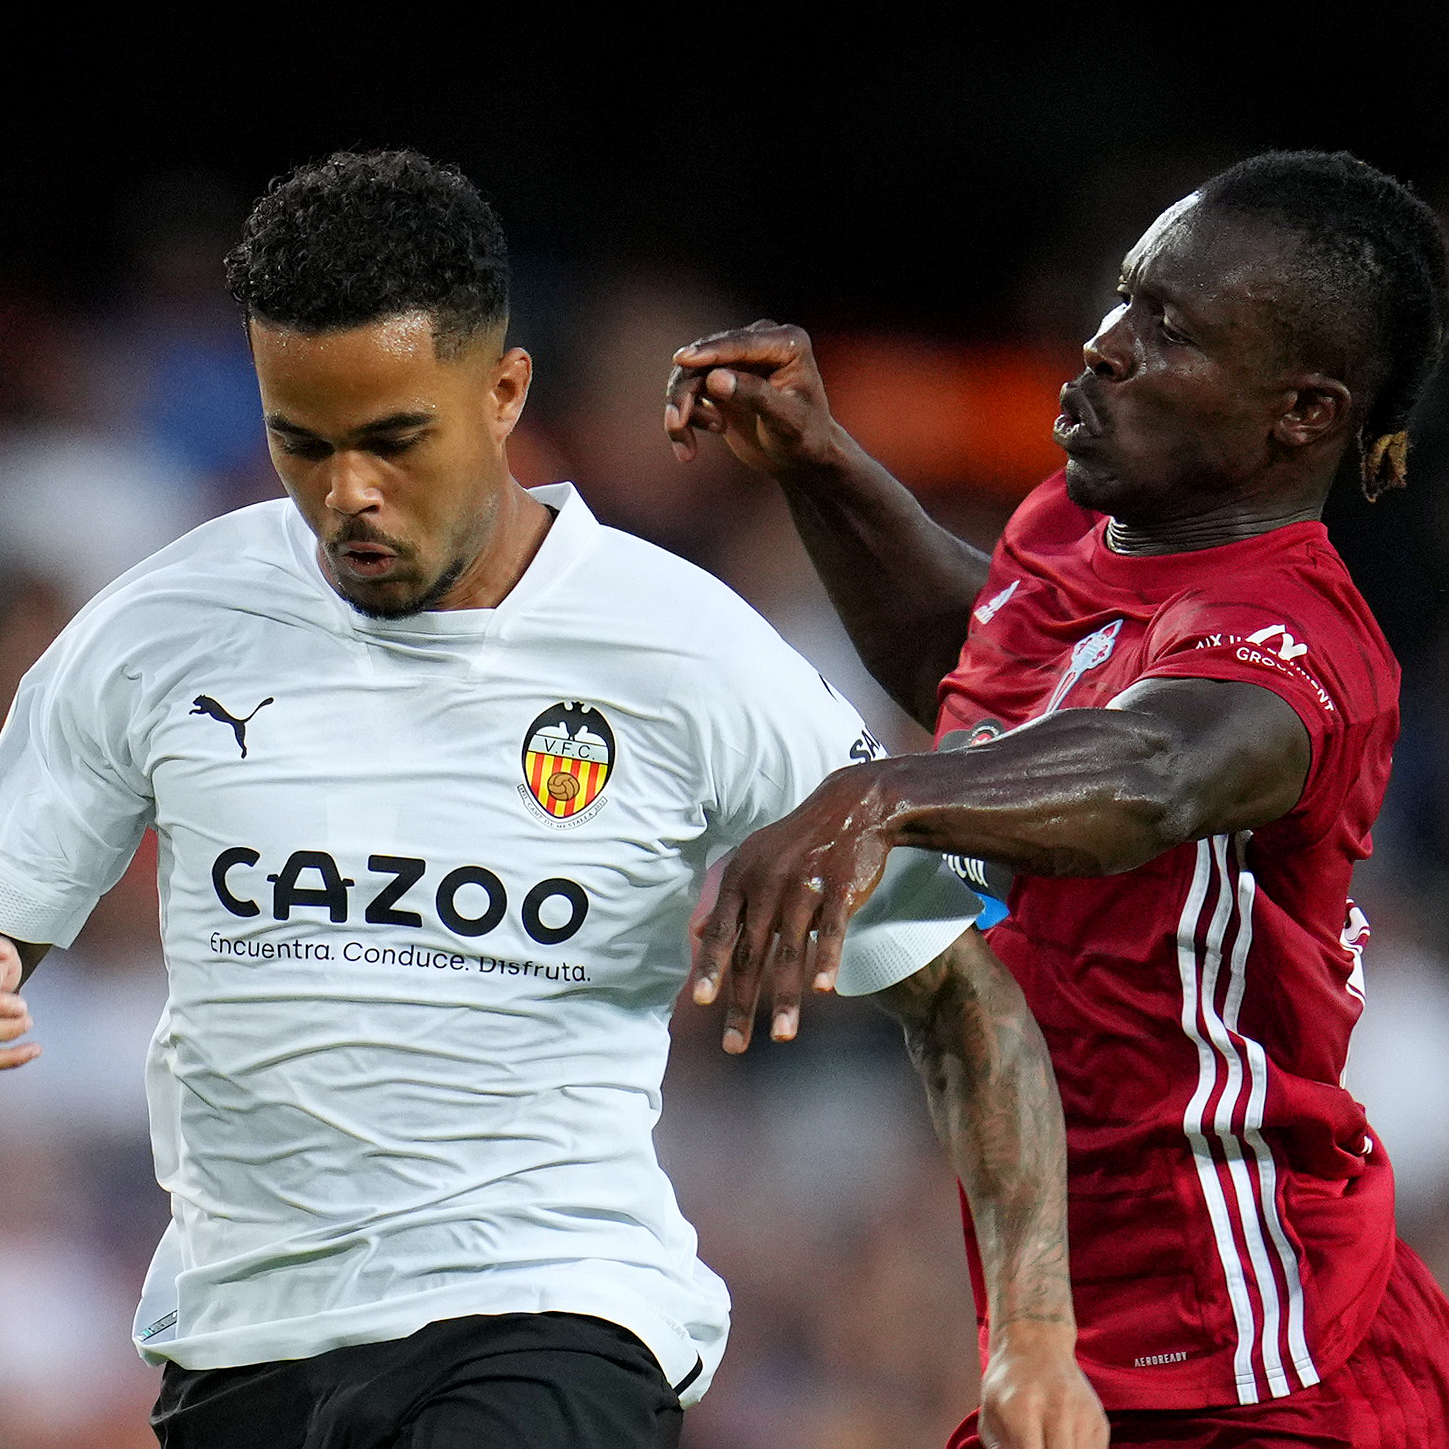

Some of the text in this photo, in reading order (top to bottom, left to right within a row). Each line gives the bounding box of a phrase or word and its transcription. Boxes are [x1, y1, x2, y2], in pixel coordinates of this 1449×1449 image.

[544, 738, 595, 760] V.F.C.
[211, 846, 590, 946] CAZOO
[210, 931, 592, 982] Encuentra. Conduce. Disfruta.
